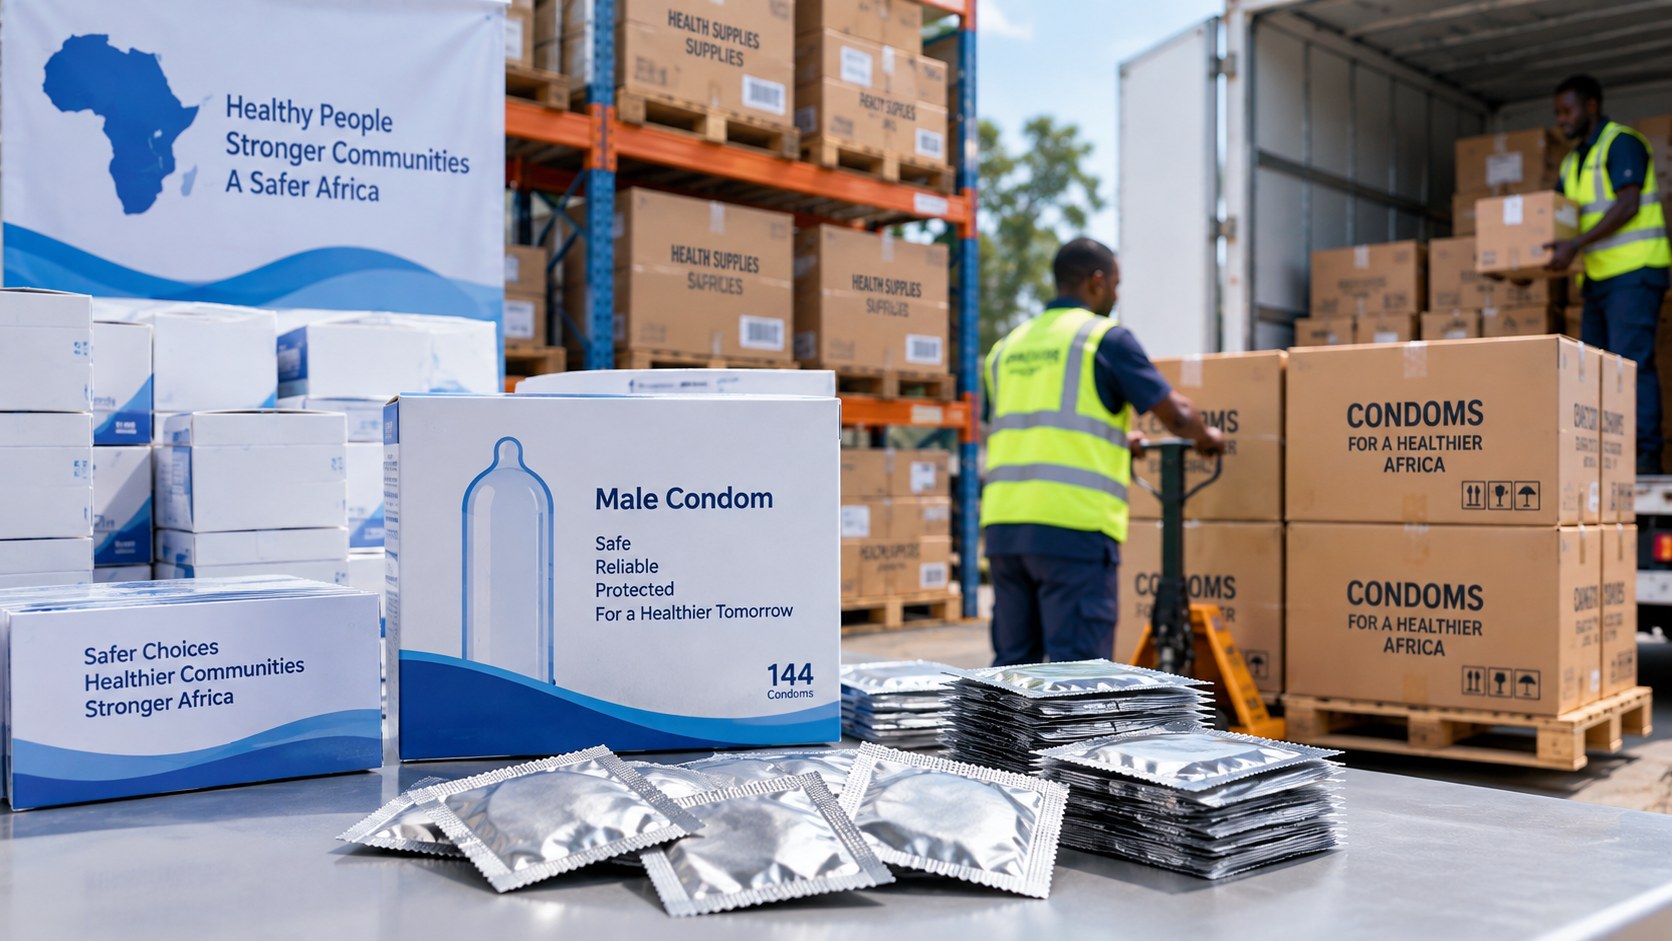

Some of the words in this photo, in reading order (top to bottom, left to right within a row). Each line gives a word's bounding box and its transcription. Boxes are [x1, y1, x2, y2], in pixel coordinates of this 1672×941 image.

[668, 9, 709, 36] HEALTH
[712, 21, 760, 50] SUPPLIES
[685, 37, 744, 68] SUPPLIES
[227, 94, 313, 130] Healthy
[321, 104, 392, 135] People
[226, 129, 325, 166] Stronger
[333, 141, 469, 174] Communities
[226, 169, 242, 193] A
[251, 171, 310, 197] Safer
[316, 176, 379, 201] Africa
[671, 244, 710, 267] HEALTH
[712, 250, 759, 274] SUPPLIES
[852, 273, 883, 294] HEALTH
[885, 278, 922, 299] SUPPLIES
[1347, 400, 1483, 428] CONDOMS
[1349, 437, 1377, 451] FOR
[1382, 436, 1392, 451] A
[1398, 435, 1482, 450] HEALTHIER
[1384, 457, 1445, 473] AFRICA
[596, 487, 658, 510] Male
[666, 486, 772, 509] Condom
[596, 535, 631, 551] Safe
[596, 558, 658, 574] Reliable
[596, 581, 673, 597] Protected
[1135, 572, 1237, 600] COOMS
[1347, 580, 1483, 611] CONDOMS
[596, 607, 621, 621] For
[627, 610, 634, 621] a
[641, 605, 712, 620] Healthier
[716, 604, 793, 618] Tomorrow
[1349, 614, 1377, 630] FOR
[1382, 616, 1392, 631] A
[1397, 617, 1482, 636] HEALTHIER
[85, 645, 137, 665] Safer
[143, 640, 218, 660] Choices
[1384, 637, 1445, 656] AFRICA
[86, 668, 175, 691] Healthier
[180, 657, 305, 682] Communities
[768, 663, 814, 686] 144
[86, 698, 173, 717] Stronger
[178, 689, 233, 709] Africa
[768, 689, 813, 699] Condoms
